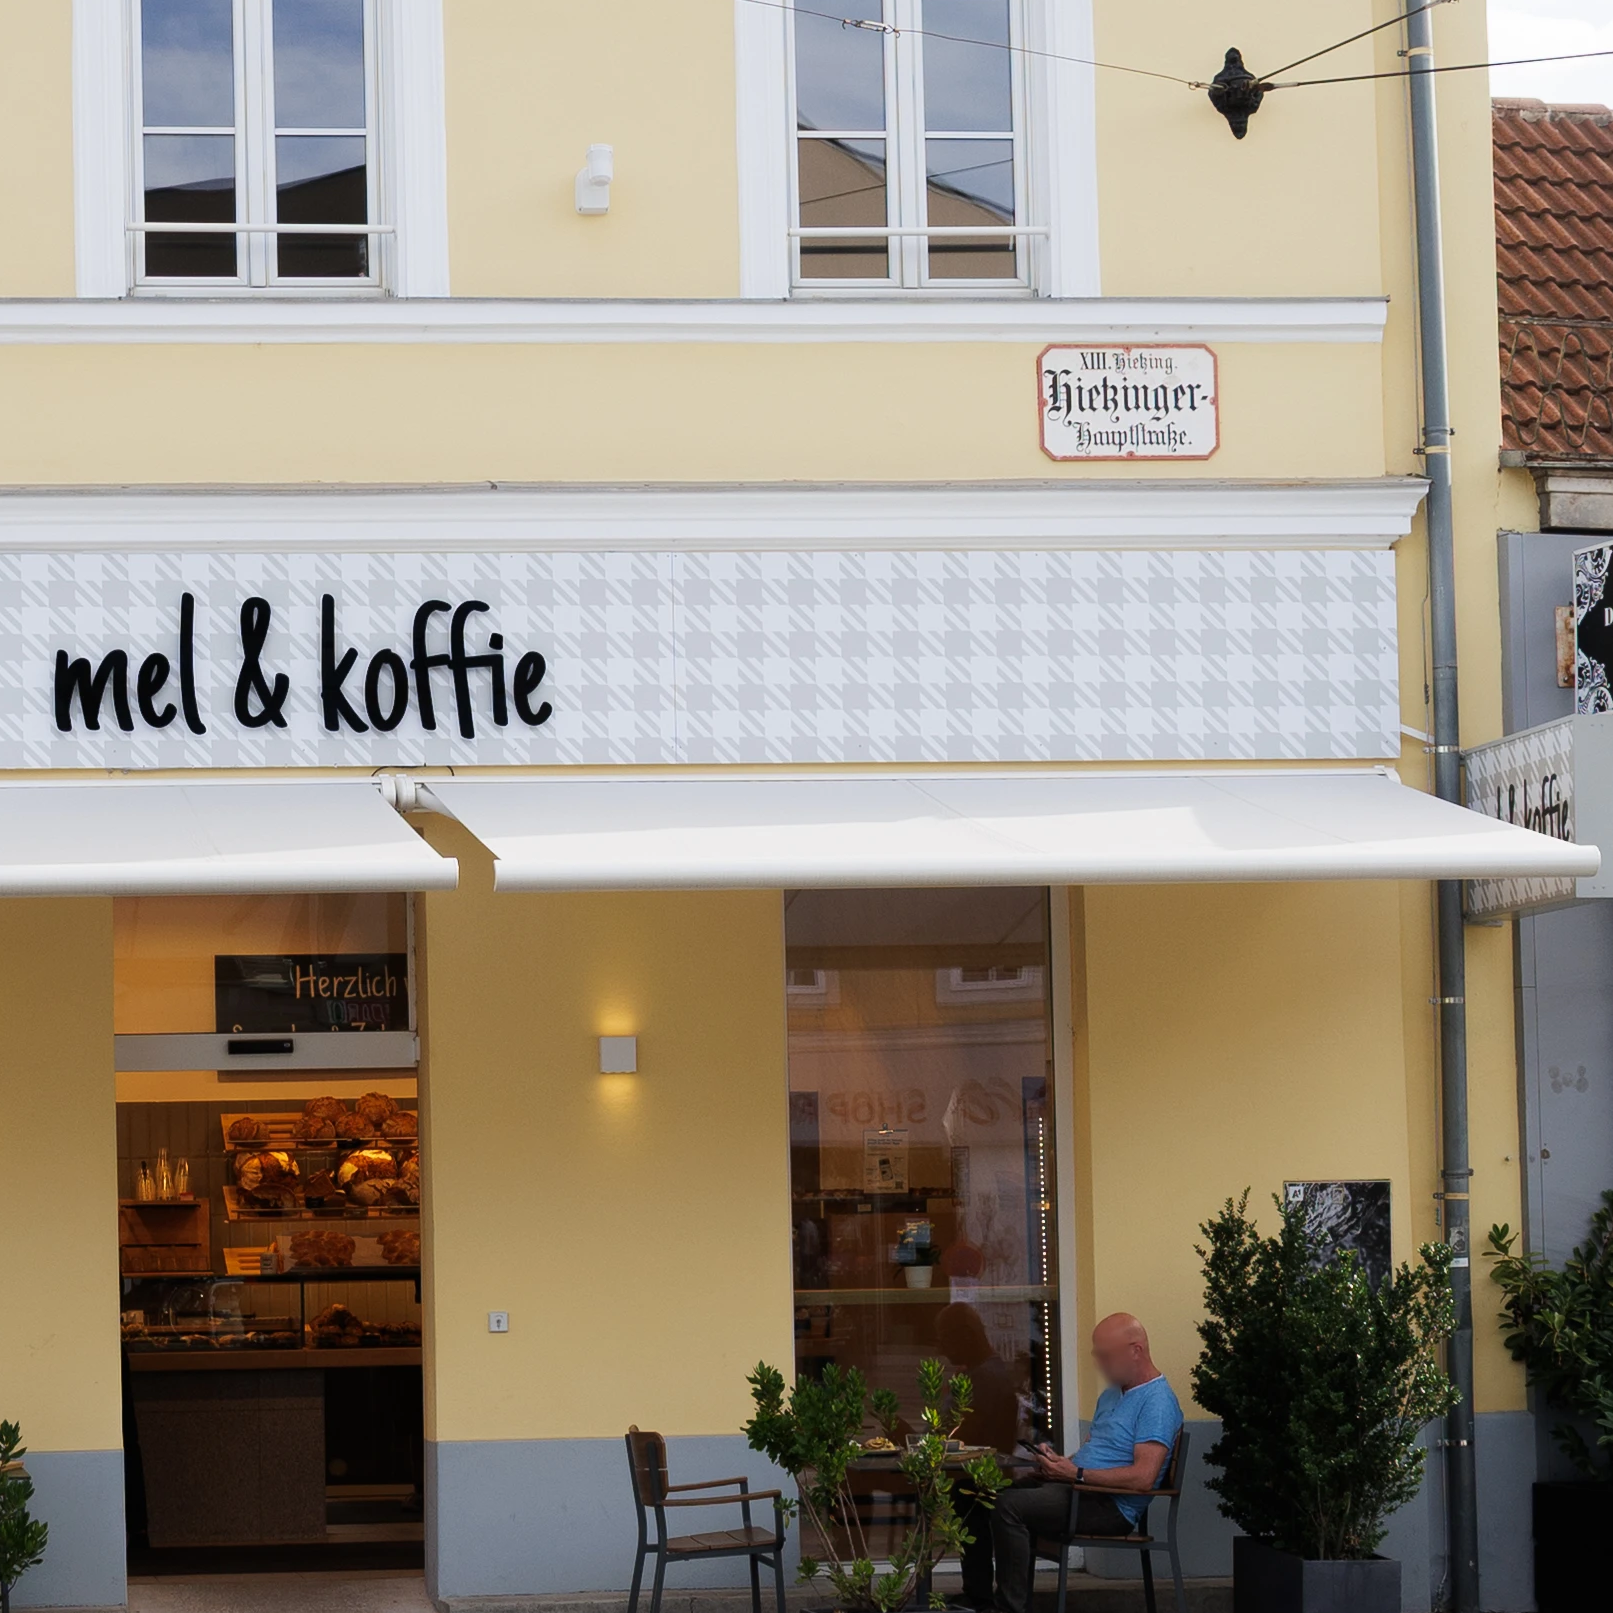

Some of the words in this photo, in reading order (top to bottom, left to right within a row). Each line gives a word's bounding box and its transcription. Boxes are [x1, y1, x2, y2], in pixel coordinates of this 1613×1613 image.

[1080, 352, 1112, 370] XIII.
[55, 591, 207, 735] mel
[234, 595, 290, 729] &
[320, 593, 553, 739] koffie
[296, 964, 396, 999] Herzlich
